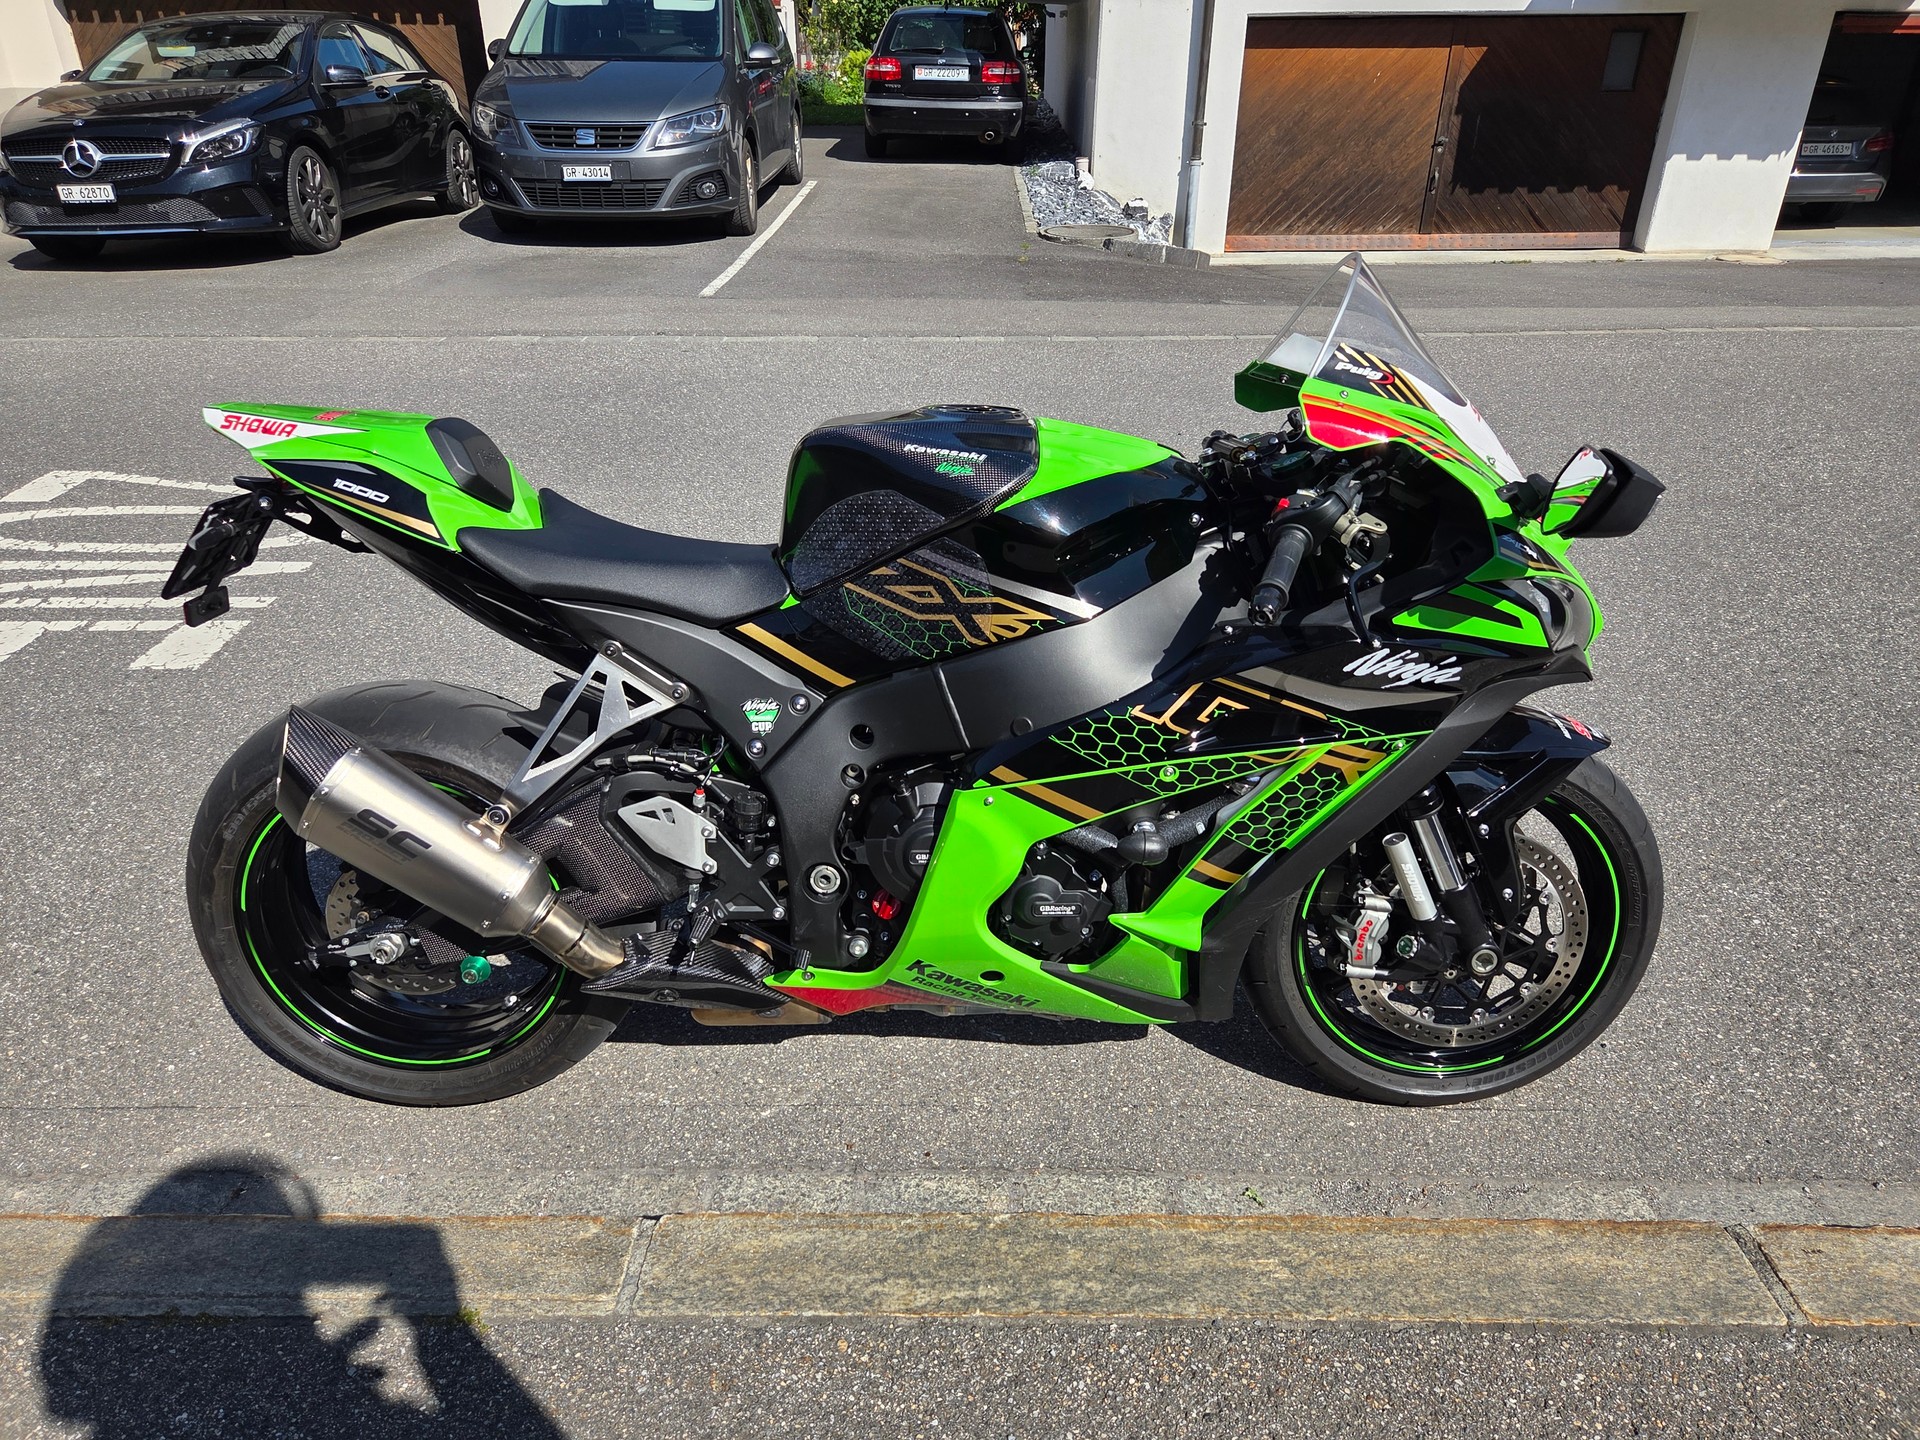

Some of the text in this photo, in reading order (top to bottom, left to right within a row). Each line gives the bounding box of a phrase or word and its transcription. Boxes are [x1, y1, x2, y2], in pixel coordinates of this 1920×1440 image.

[1334, 361, 1384, 380] Puig
[220, 414, 298, 437] SHOWA
[903, 443, 988, 463] Kawasaki
[332, 478, 390, 504] 1000
[1342, 647, 1463, 689] Ninja
[741, 698, 781, 715] Ninja
[751, 721, 773, 733] CUP
[1353, 919, 1374, 961] brembo
[905, 958, 1042, 1009] Kawasaki
[910, 976, 967, 997] Racing
